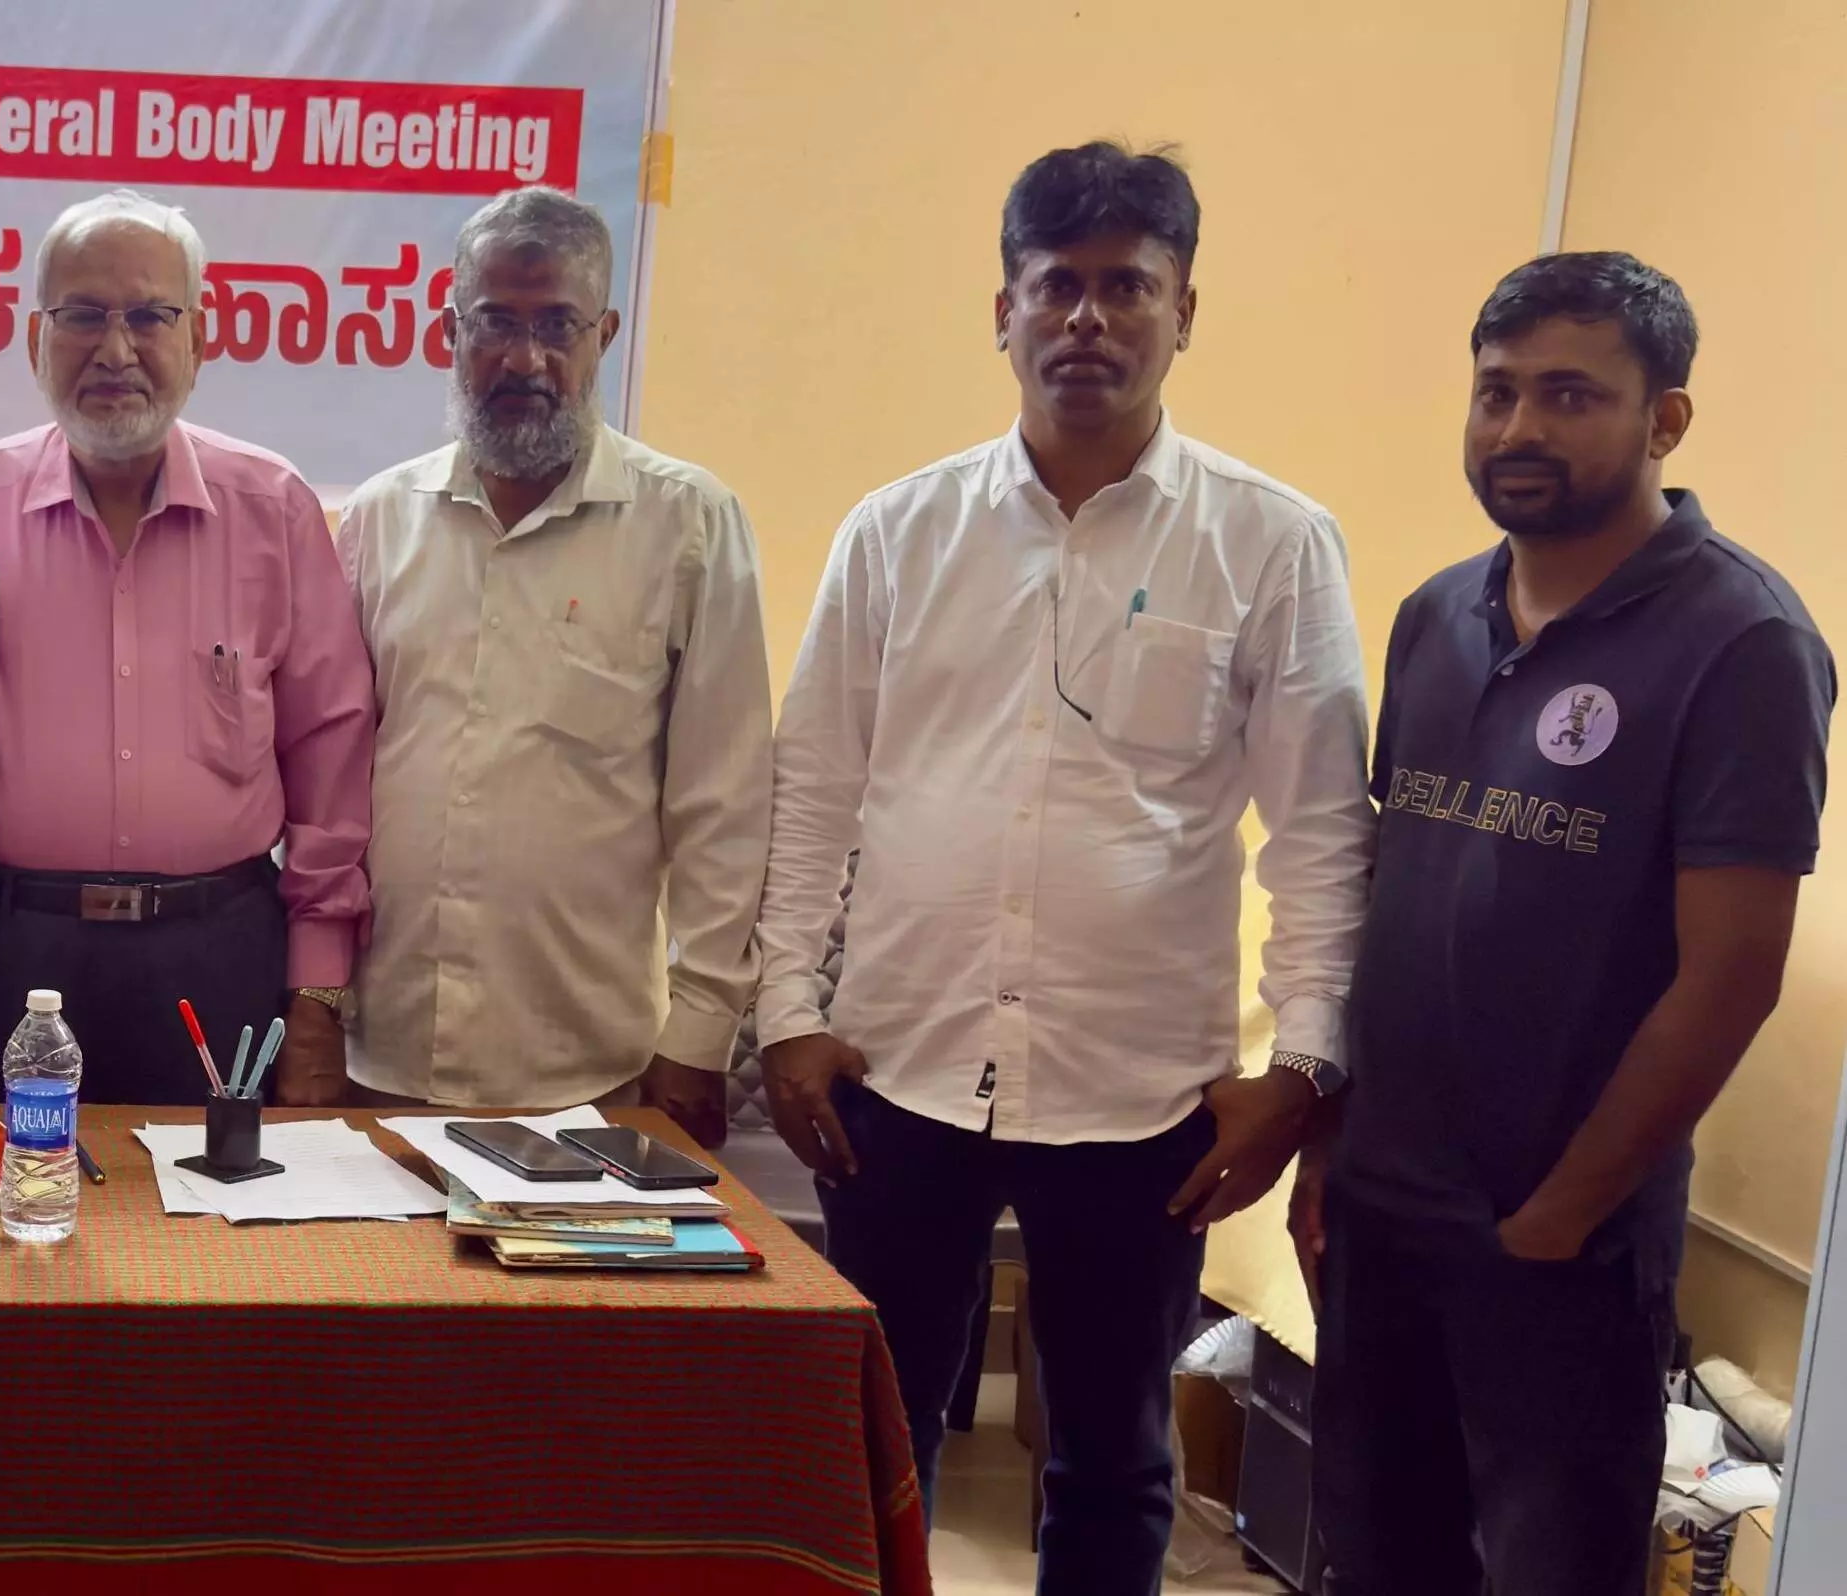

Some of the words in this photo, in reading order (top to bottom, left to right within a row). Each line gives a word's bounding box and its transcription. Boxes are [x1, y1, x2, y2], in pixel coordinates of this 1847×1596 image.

[136, 89, 285, 172] Body
[302, 97, 551, 181] Meeting
[1386, 767, 1607, 853] CELLENCE
